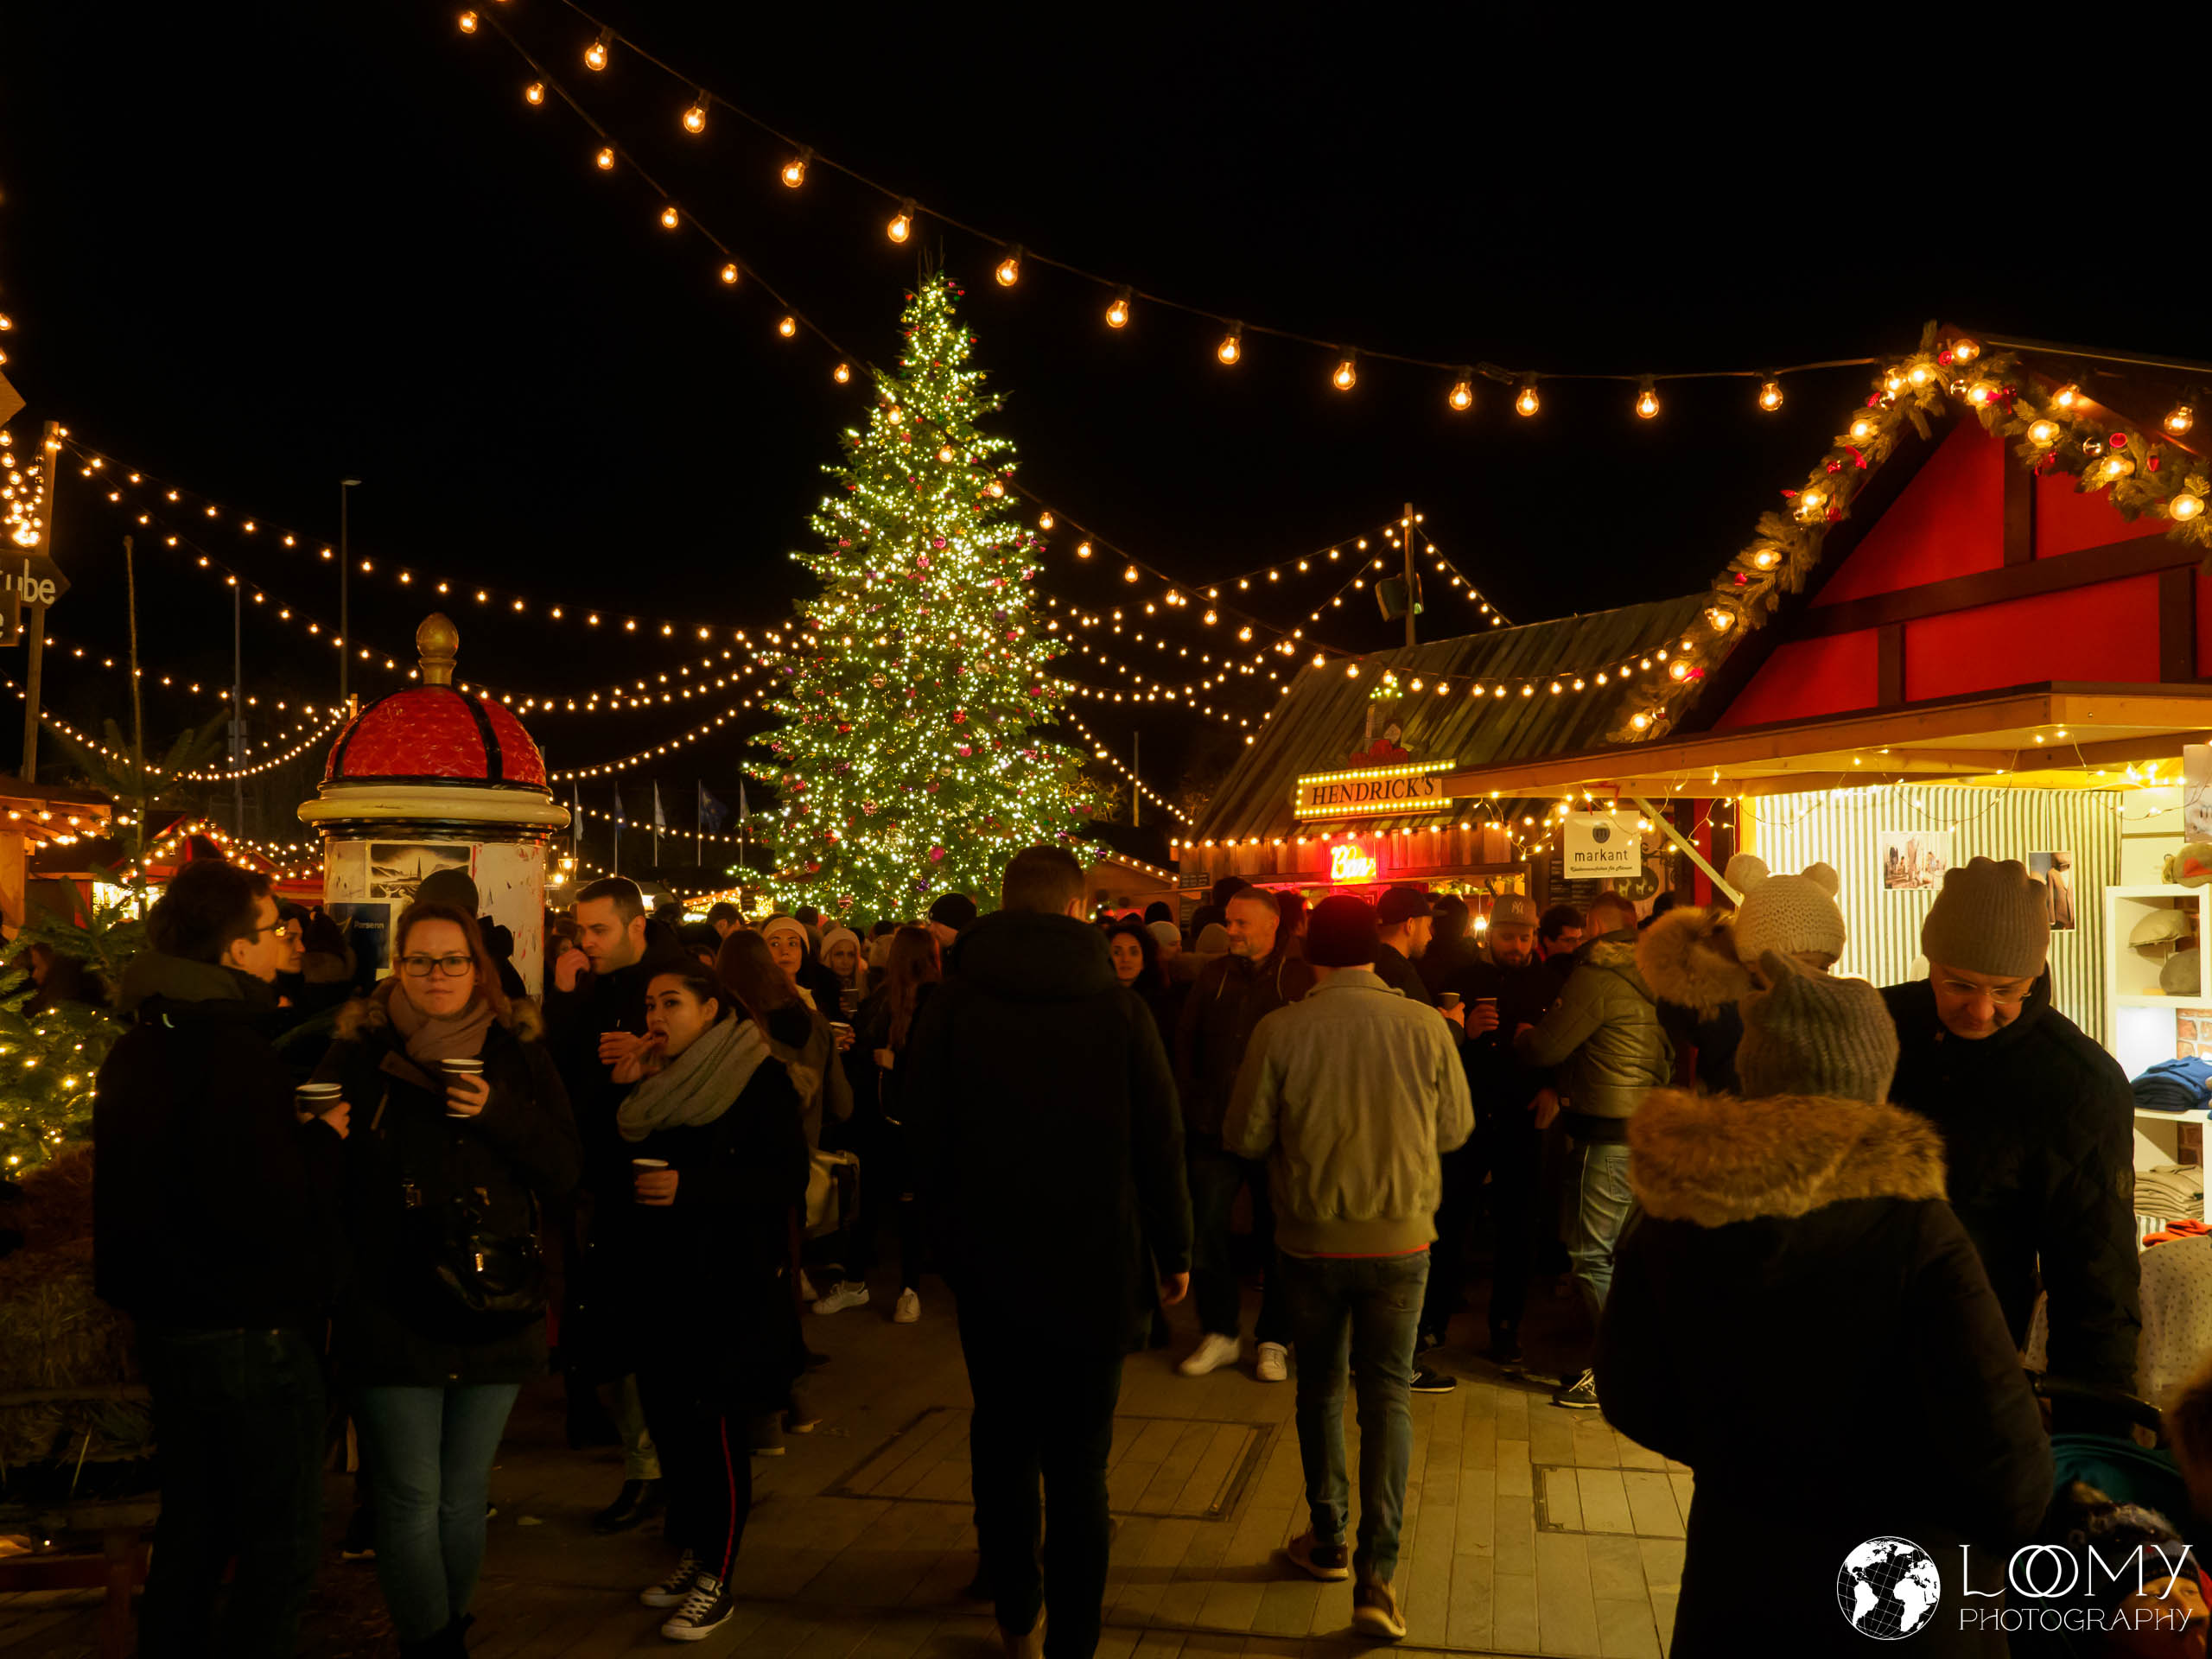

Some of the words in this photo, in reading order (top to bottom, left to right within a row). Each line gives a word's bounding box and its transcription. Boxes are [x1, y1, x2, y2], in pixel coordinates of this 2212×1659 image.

[0, 558, 56, 605] ube
[1312, 776, 1435, 805] HENDRICK'S
[1331, 844, 1376, 879] Bar
[1574, 849, 1629, 862] markant
